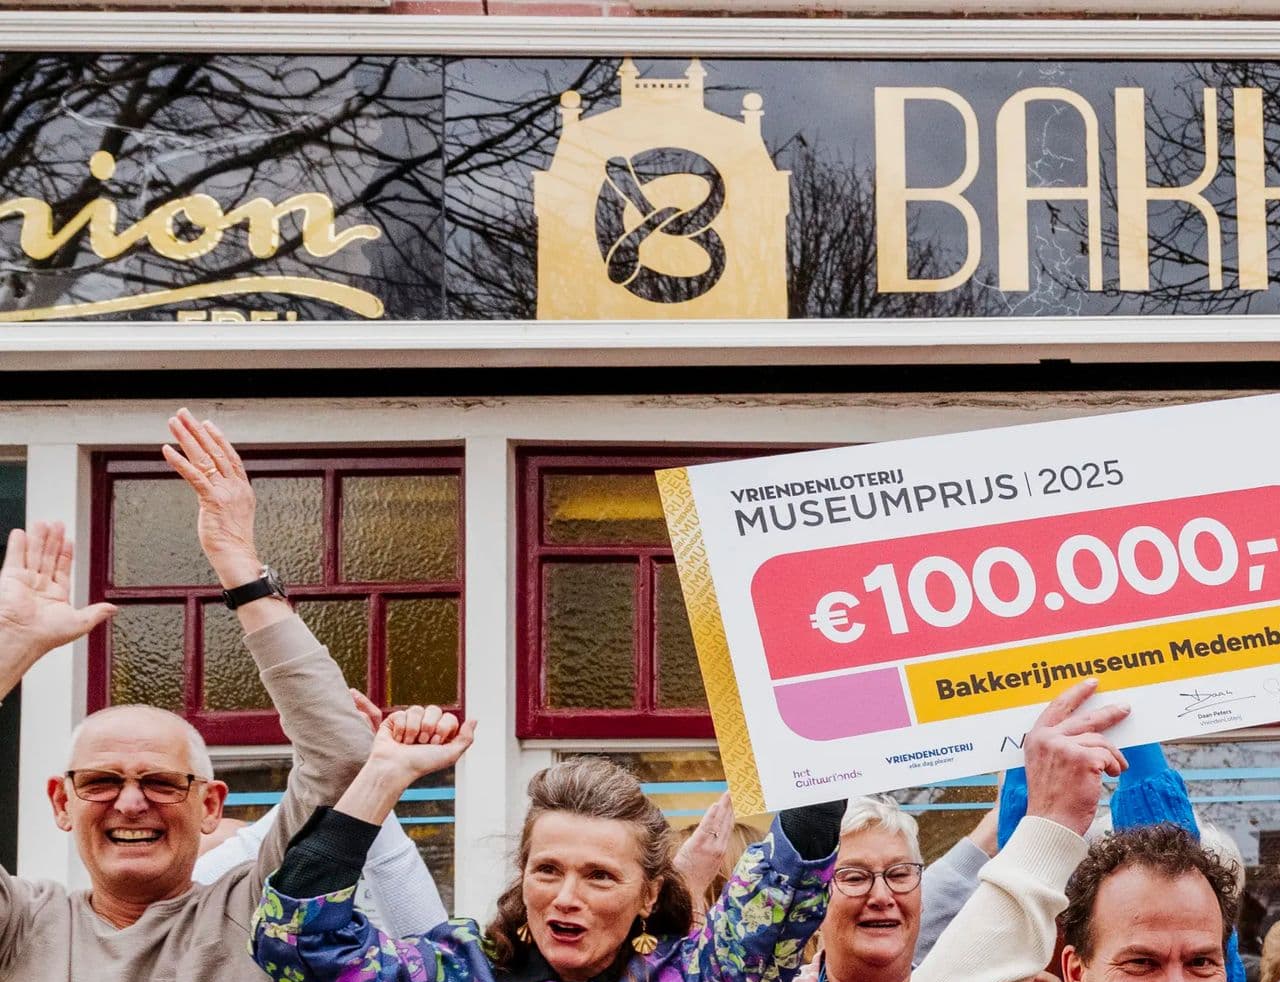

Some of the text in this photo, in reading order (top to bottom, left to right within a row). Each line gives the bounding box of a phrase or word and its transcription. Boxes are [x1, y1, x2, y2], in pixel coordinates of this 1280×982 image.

[730, 469, 904, 503] VRIENDENLOTERIJ
[735, 460, 1124, 536] MUSEUMPRIJS 2025
[936, 648, 1165, 700] Bakkerijmuseum
[885, 742, 974, 765] VRIENDENLOTERIJ
